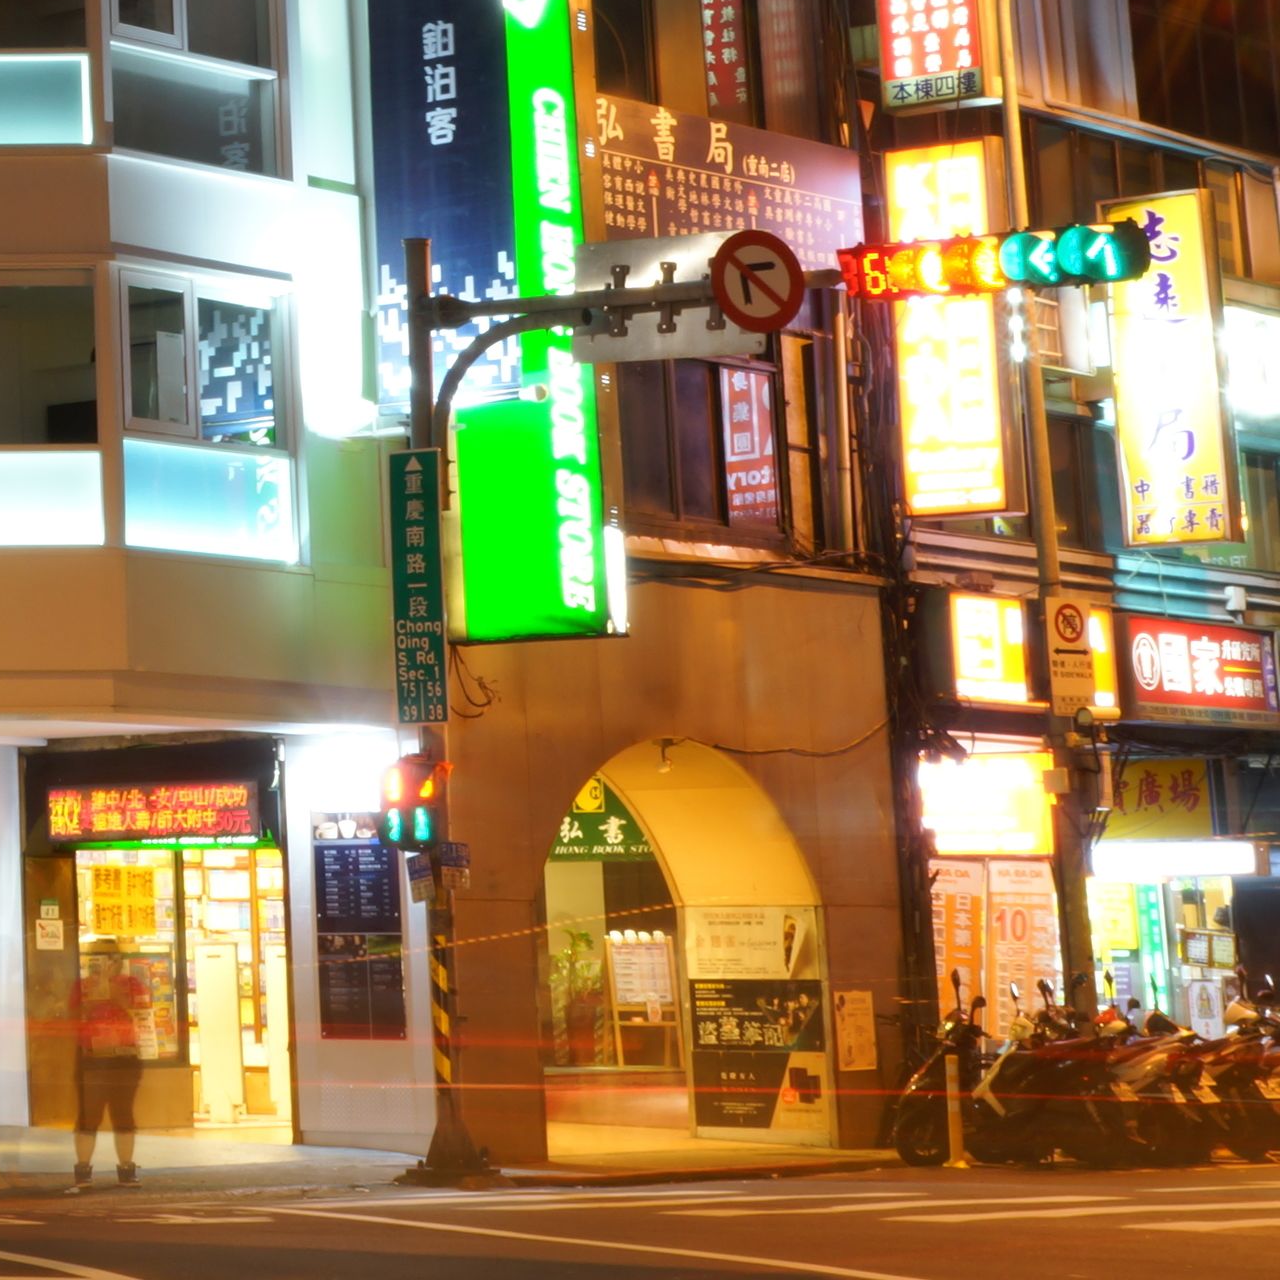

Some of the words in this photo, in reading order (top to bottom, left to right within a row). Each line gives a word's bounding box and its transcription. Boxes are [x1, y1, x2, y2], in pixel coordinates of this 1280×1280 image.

[421, 19, 458, 148] 鉑泊客
[891, 70, 978, 104] 本棟四樓
[533, 87, 571, 212] CHIEN
[555, 470, 597, 612] STORE
[404, 472, 428, 618] 重慶南路一段
[396, 620, 443, 636] Chong
[397, 635, 429, 652] Qing
[398, 652, 410, 666] S.
[416, 650, 439, 665] Rd.
[398, 667, 429, 681] Sec.
[402, 682, 417, 697] 75
[427, 681, 442, 696] 56
[403, 706, 417, 720] 39
[428, 705, 444, 720] 38
